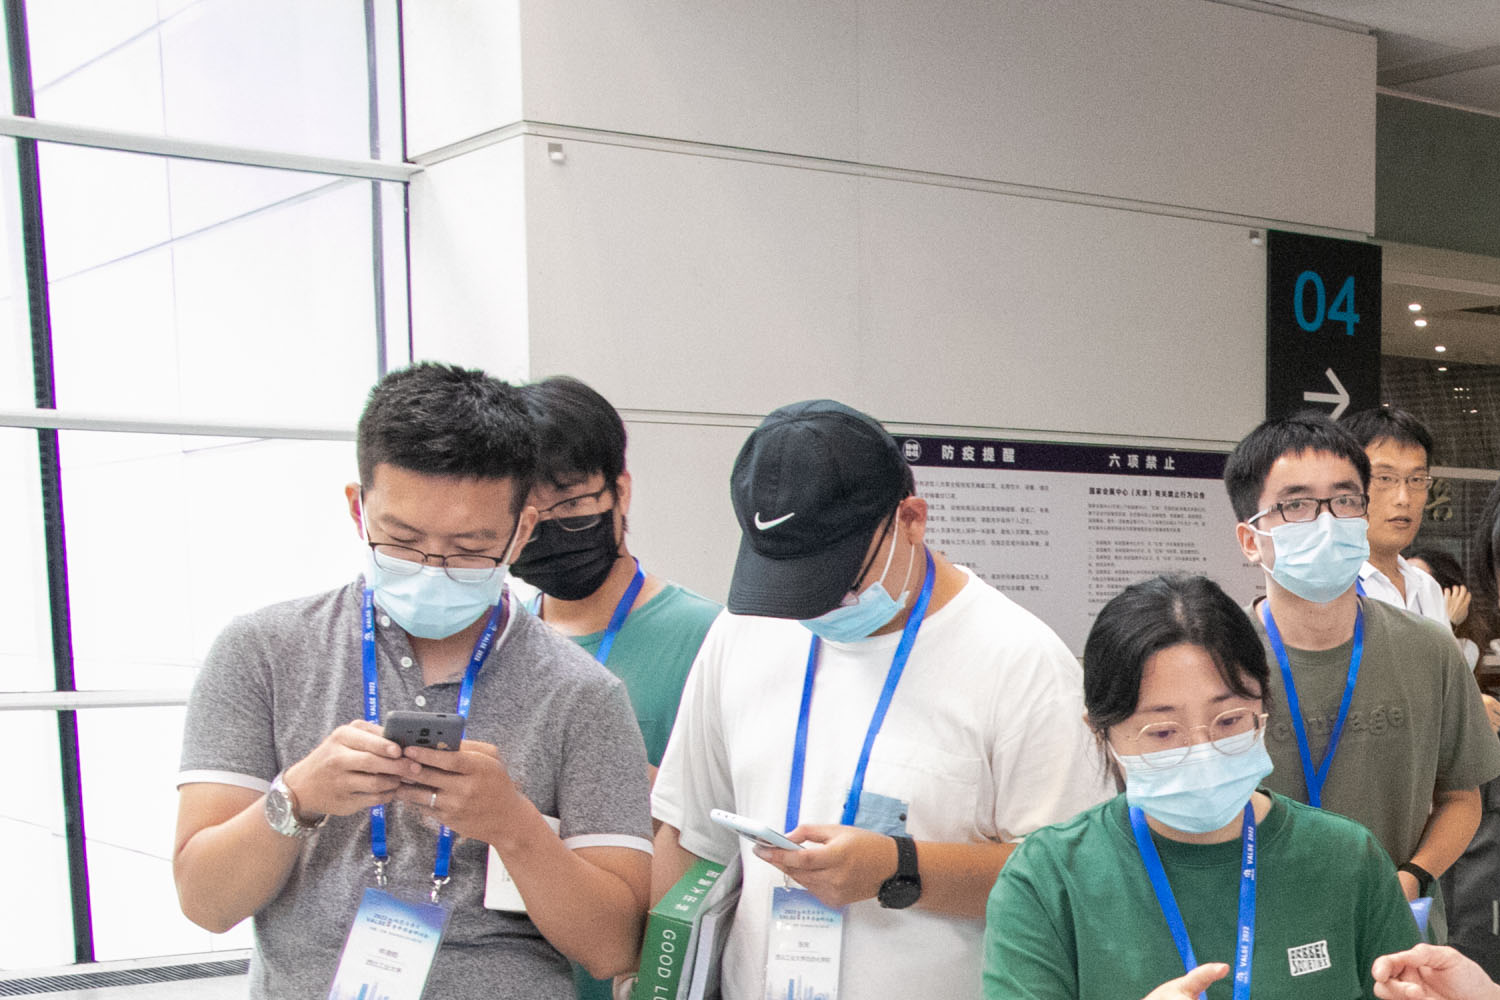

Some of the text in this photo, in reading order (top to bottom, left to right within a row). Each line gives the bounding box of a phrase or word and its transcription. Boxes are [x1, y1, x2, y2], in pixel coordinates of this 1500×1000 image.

[1293, 271, 1360, 336] 04
[941, 444, 1016, 463] 防疫提醒
[1108, 453, 1176, 471] 六项禁止
[657, 929, 676, 979] GOOD
[1240, 946, 1248, 967] VALSE
